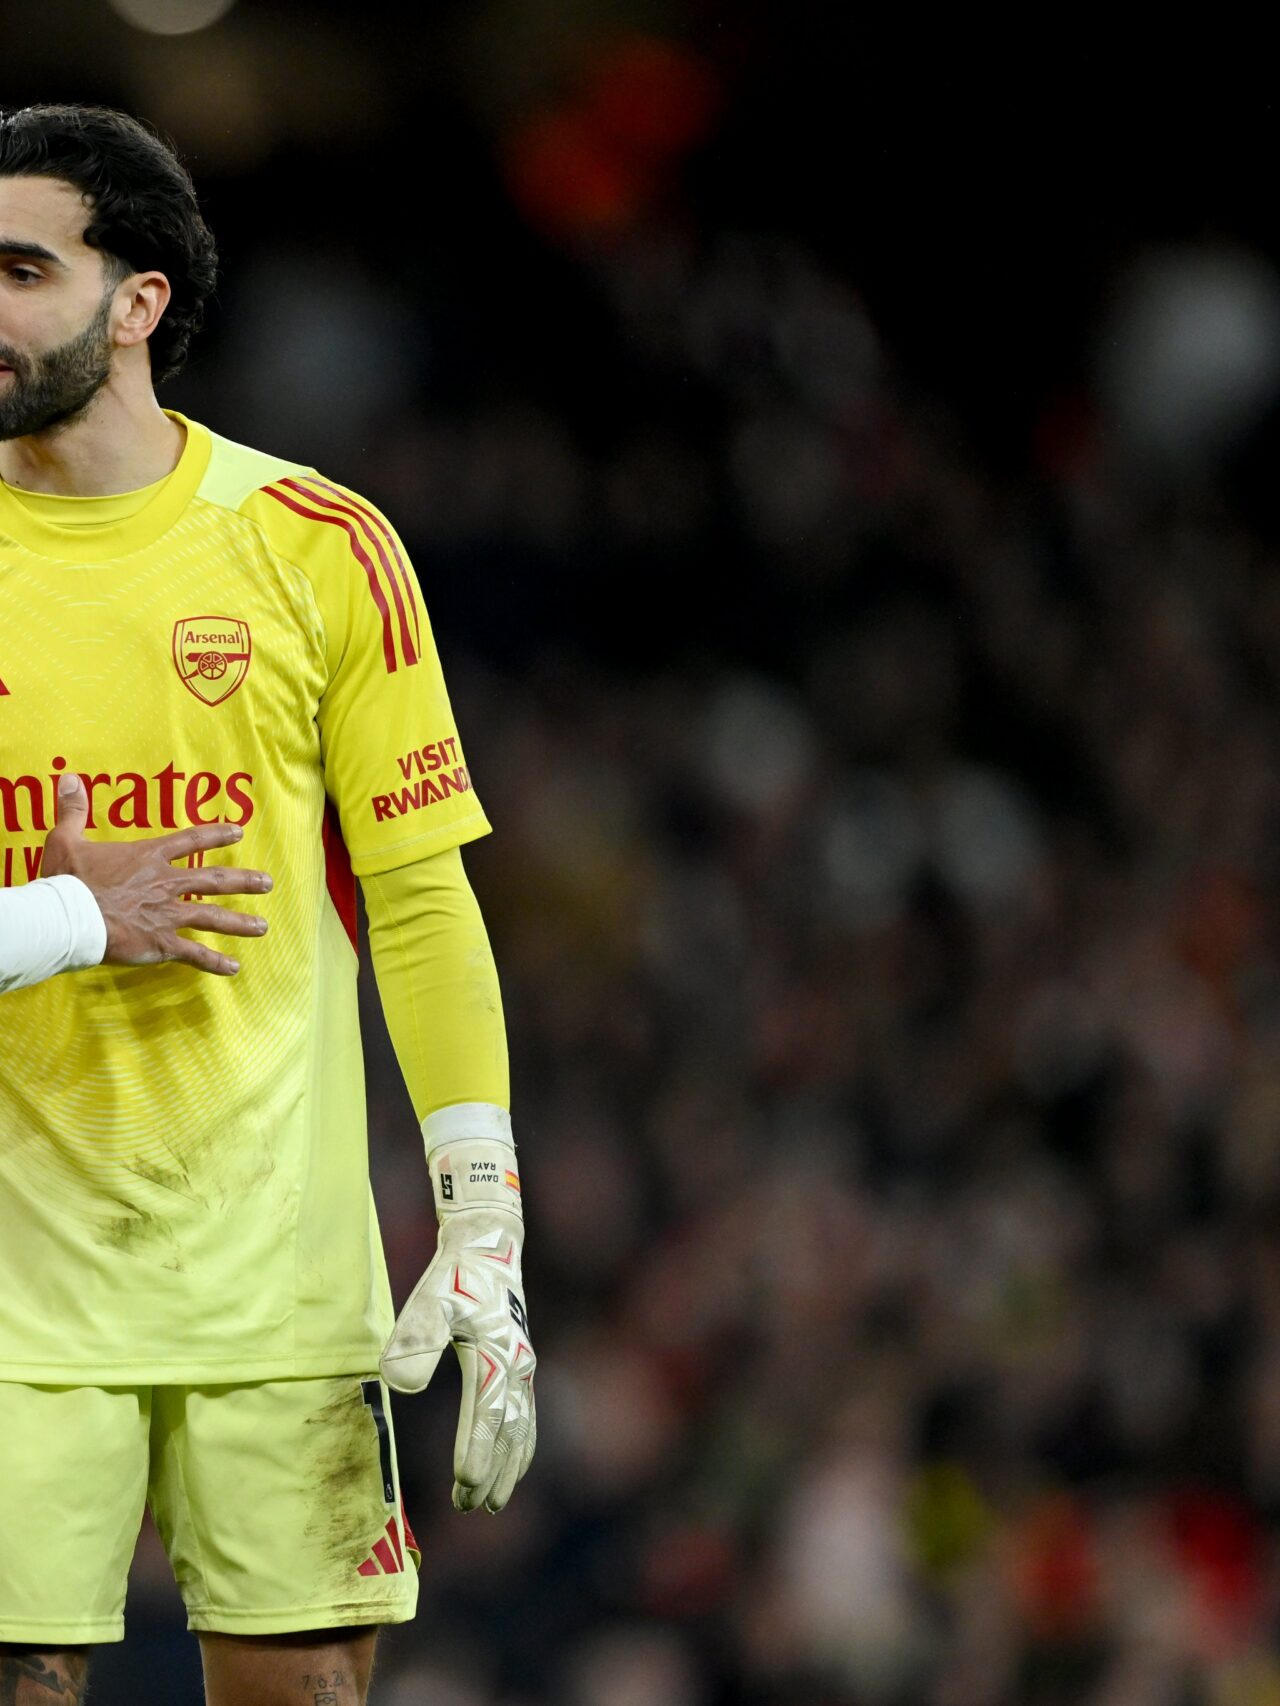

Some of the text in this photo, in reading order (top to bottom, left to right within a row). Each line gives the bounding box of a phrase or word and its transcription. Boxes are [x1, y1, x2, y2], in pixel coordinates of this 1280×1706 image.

[184, 631, 240, 644] Arsenal
[396, 737, 458, 780] VISIT
[371, 766, 472, 823] RWAND
[470, 1162, 497, 1171] RAYA
[469, 1174, 499, 1183] DAVID
